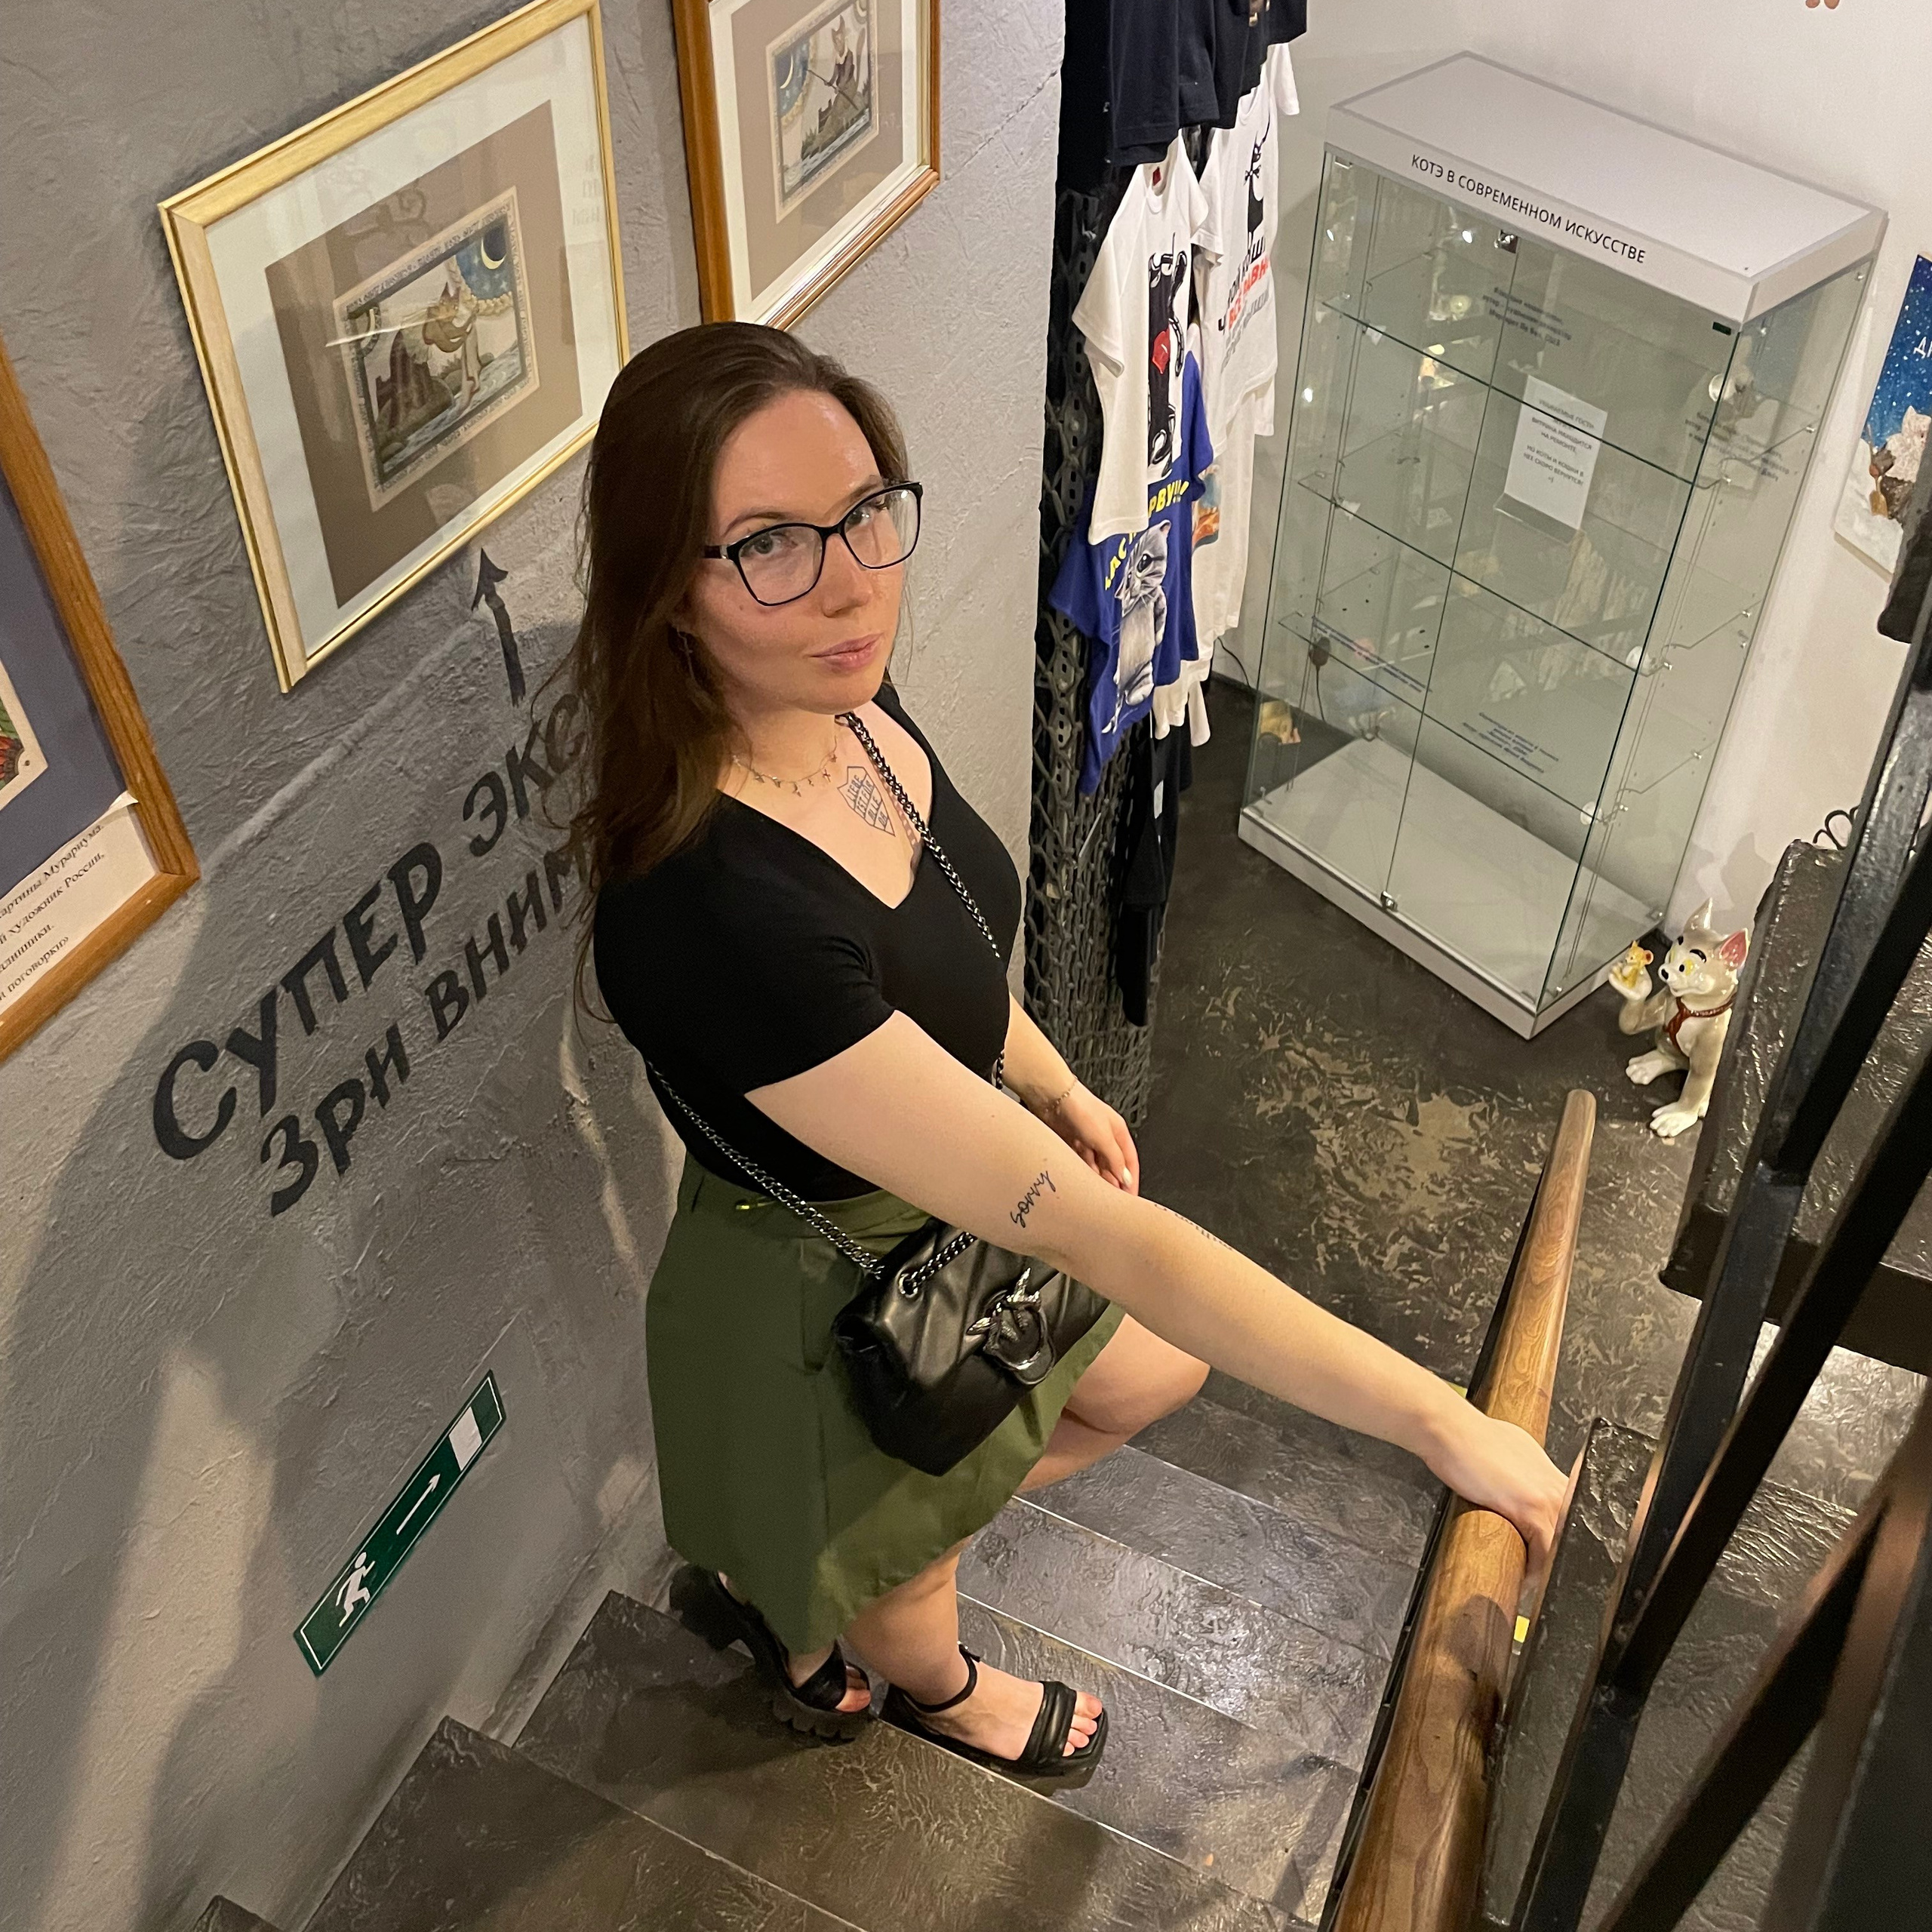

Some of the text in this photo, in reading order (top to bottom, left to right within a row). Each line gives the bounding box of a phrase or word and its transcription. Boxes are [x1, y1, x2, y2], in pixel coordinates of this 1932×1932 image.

[1411, 154, 1647, 264] КОТЭ В СОВРЕМЕННОМ ИСКУССТВЕ
[1912, 336, 1932, 359] Д
[8, 886, 63, 935] художник
[152, 693, 588, 1161] СУПЕР ЭКС
[8, 937, 69, 992] поговорки»
